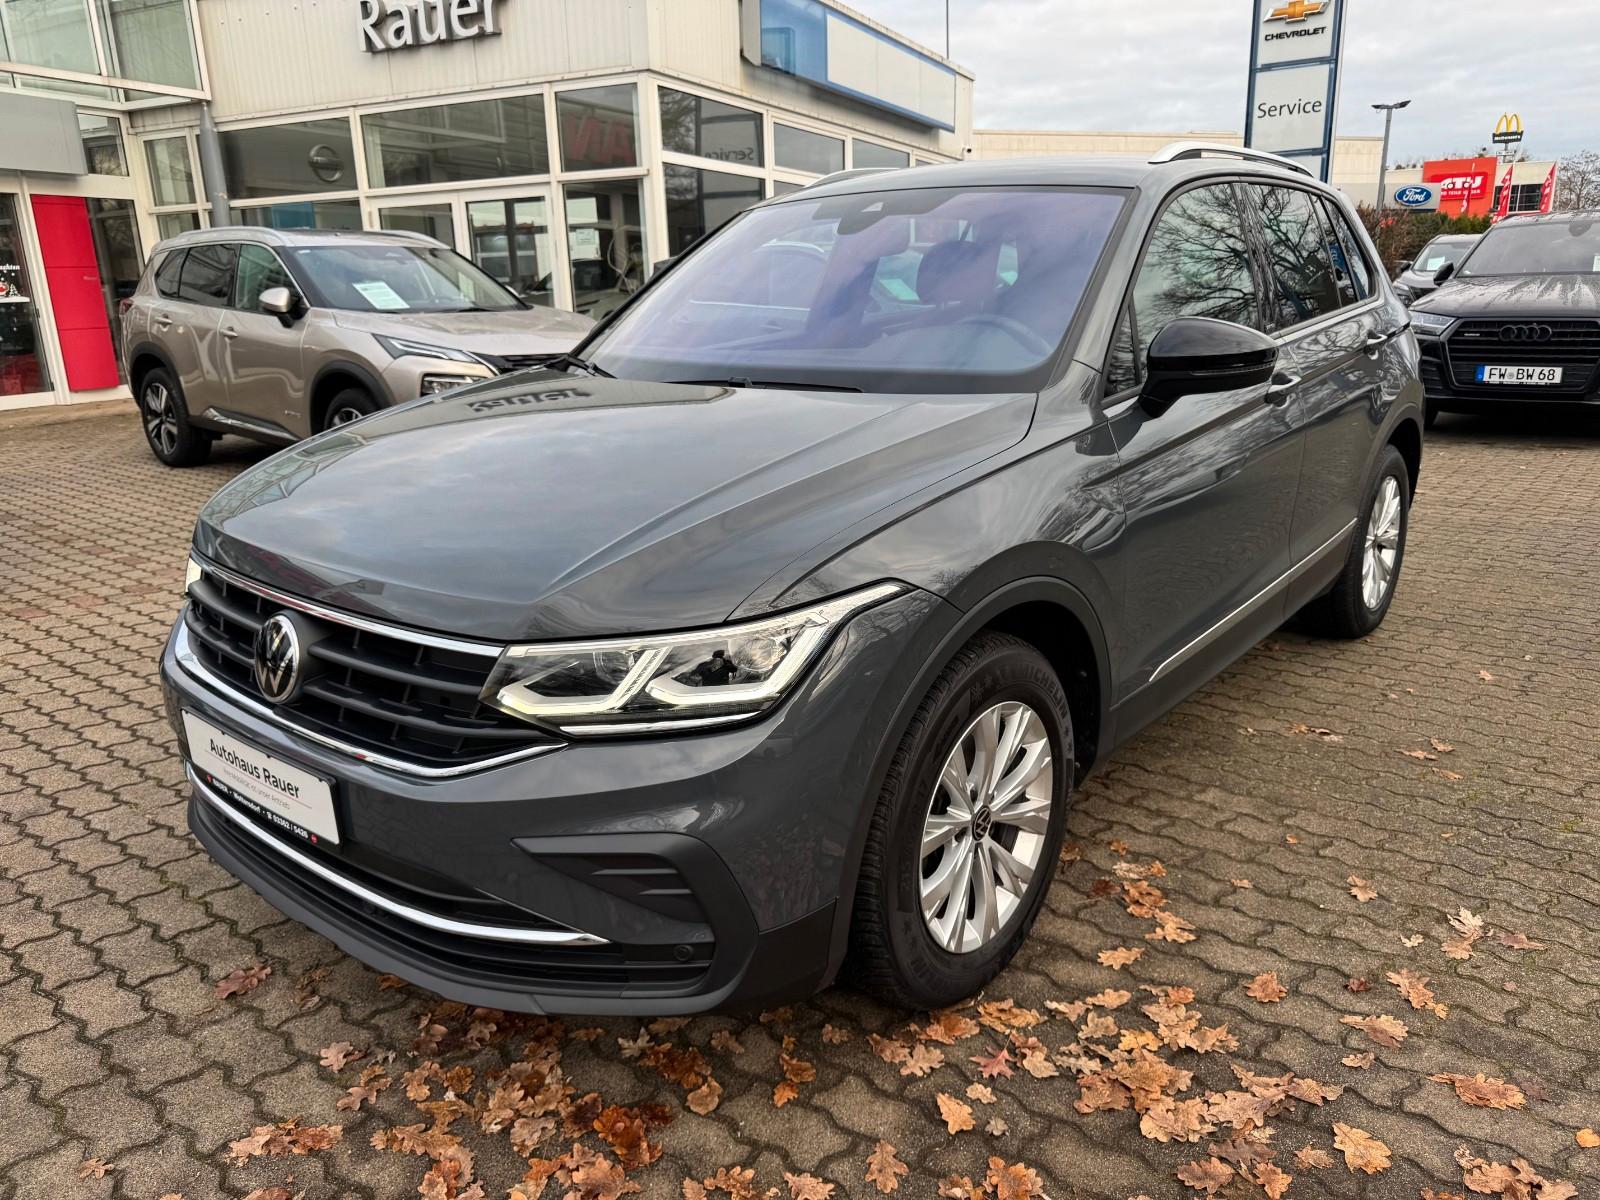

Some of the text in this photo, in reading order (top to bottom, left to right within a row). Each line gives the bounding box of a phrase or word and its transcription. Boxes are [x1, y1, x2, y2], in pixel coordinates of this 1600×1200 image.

[358, 0, 501, 52] Rauer
[1264, 26, 1327, 41] CHEVROLET
[1256, 98, 1322, 119] Service
[1402, 187, 1426, 202] Ford
[1488, 367, 1556, 381] FW BW 68
[209, 738, 261, 779] Autohaus
[262, 767, 300, 799] Rauer
